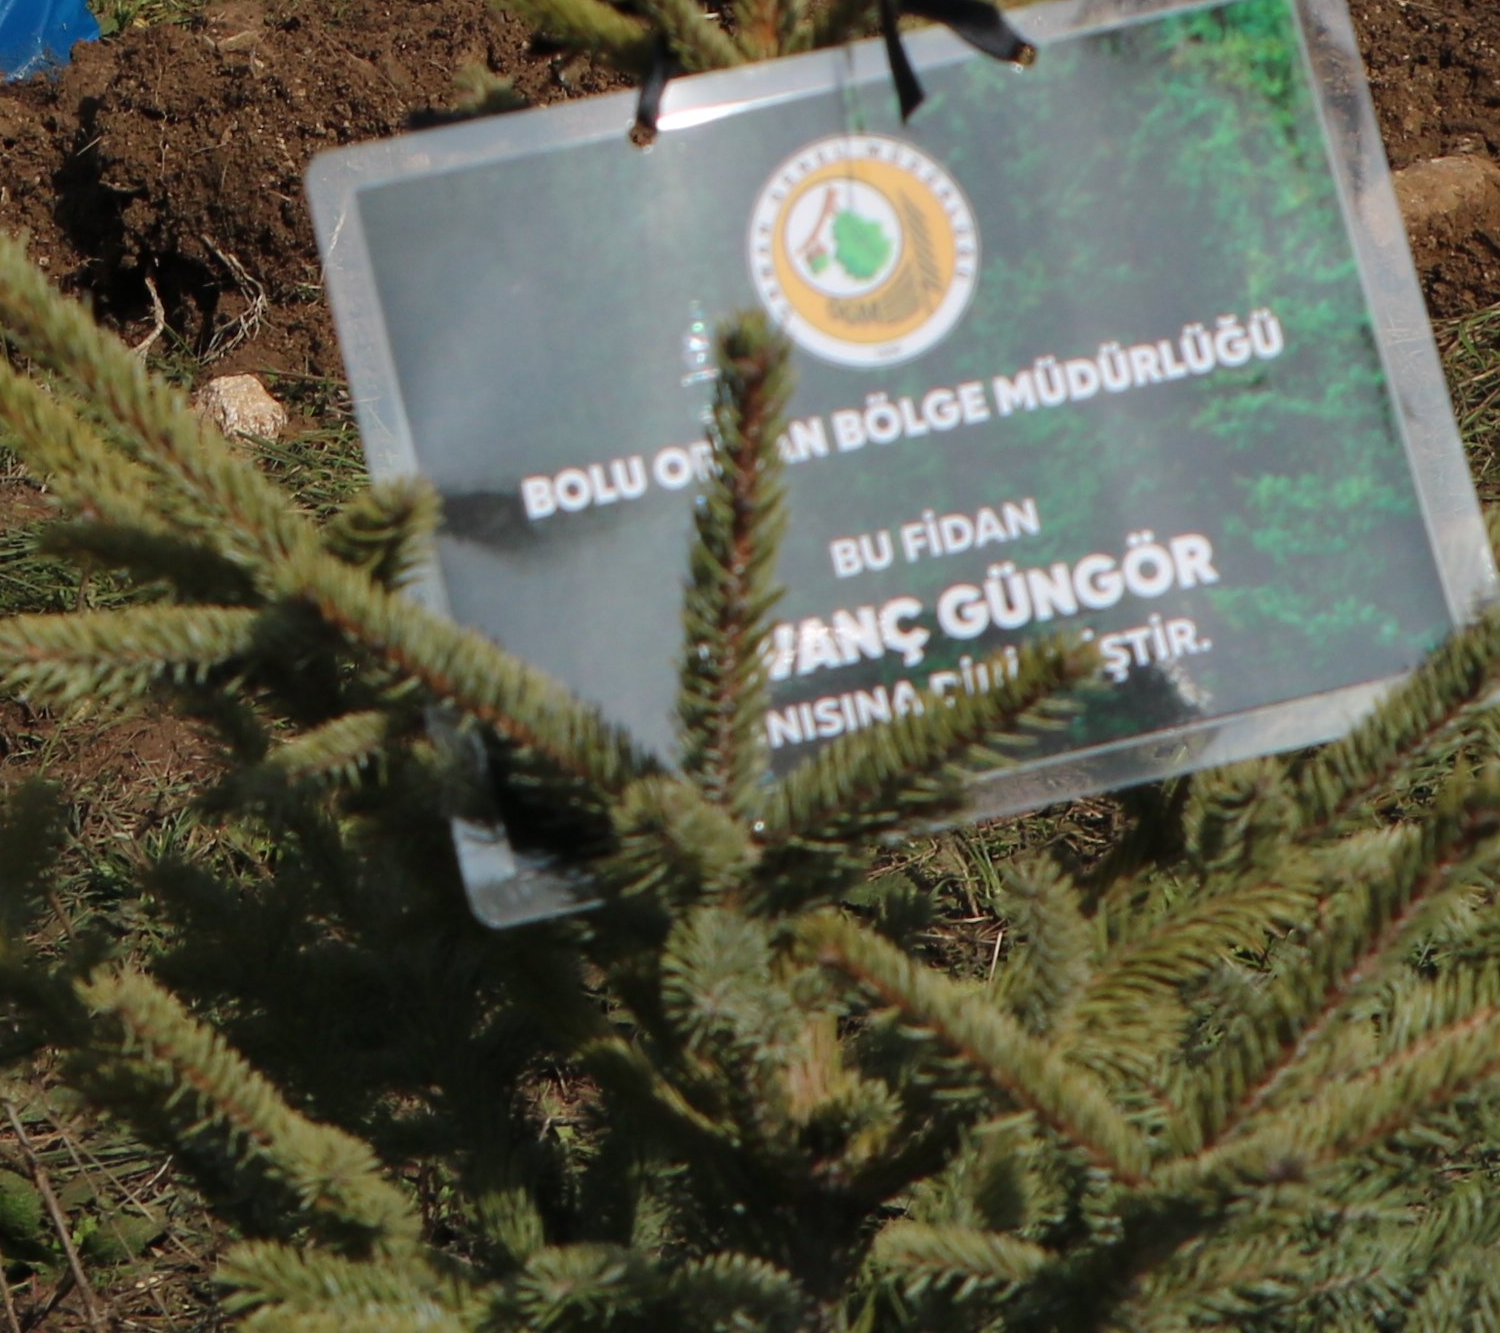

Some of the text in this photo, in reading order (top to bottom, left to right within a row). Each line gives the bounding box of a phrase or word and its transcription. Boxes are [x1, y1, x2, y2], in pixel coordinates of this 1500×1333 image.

[521, 455, 648, 520] BOLU
[831, 381, 991, 453] BÖLGE
[992, 308, 1284, 416] MÜDÜRLÜĞÜ
[830, 497, 1041, 579] BU FİDAN
[937, 529, 1219, 640] GÜNGÖR
[762, 679, 925, 748] NISINA
